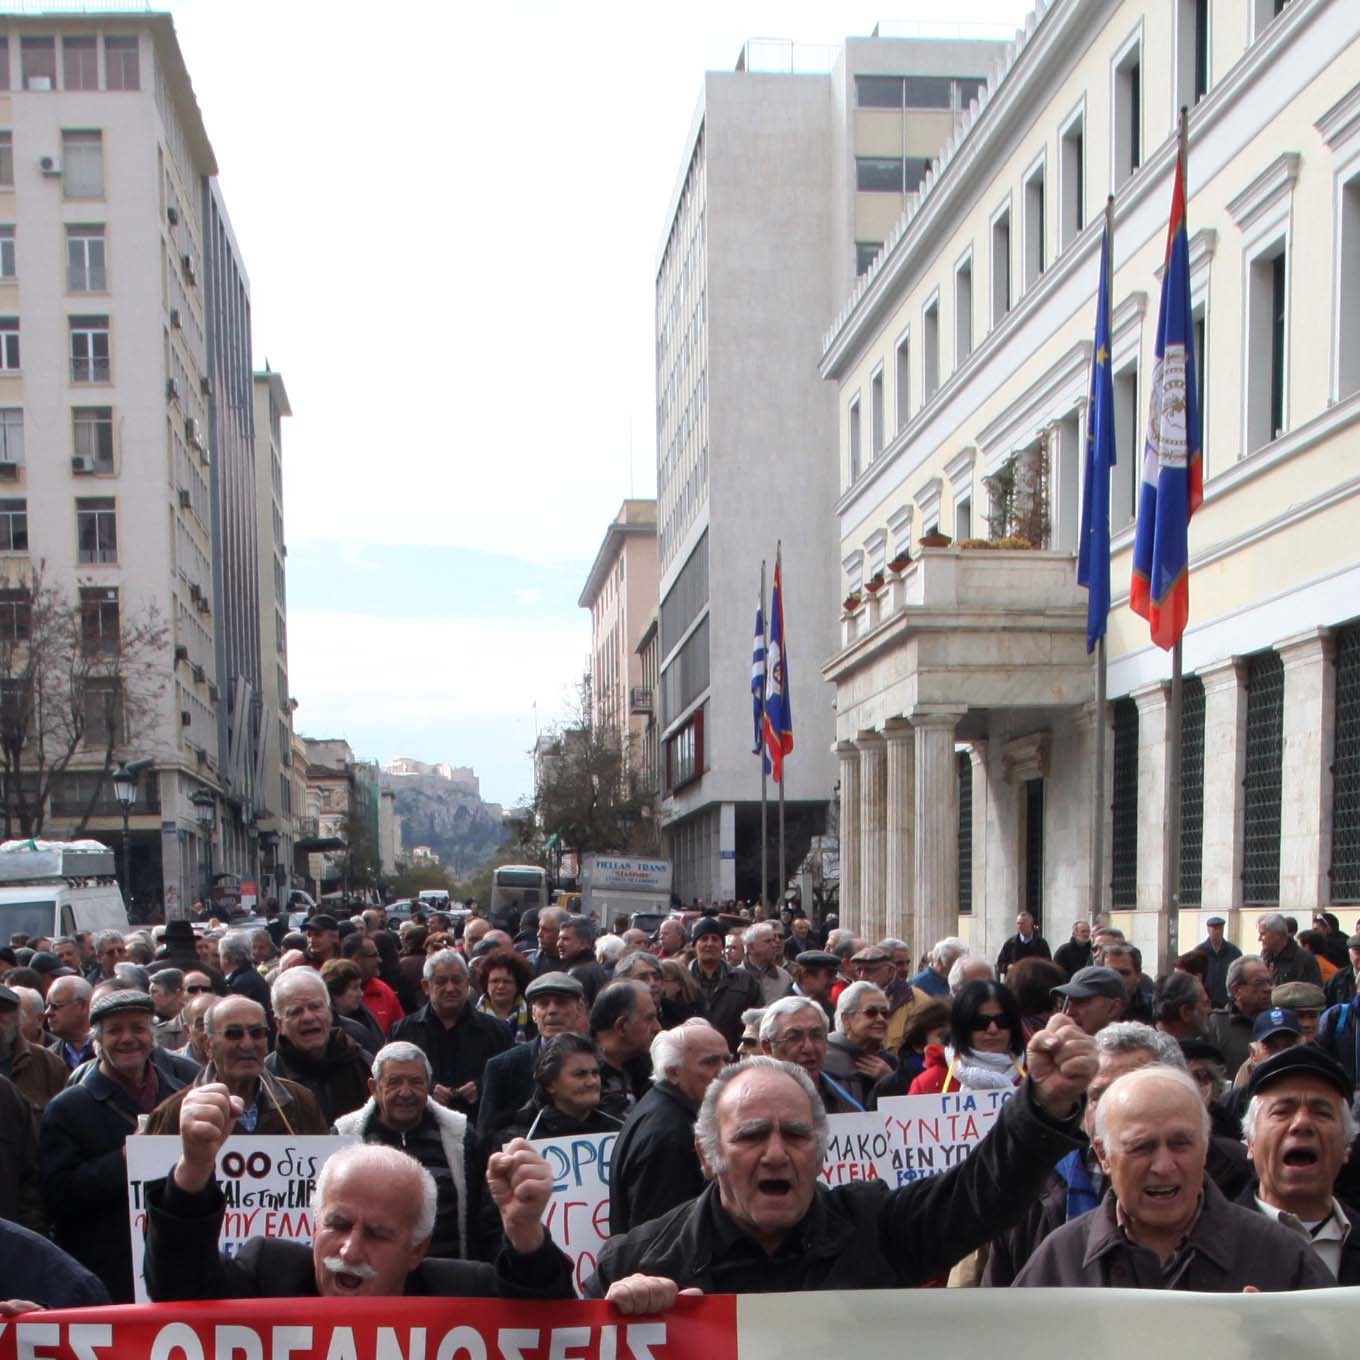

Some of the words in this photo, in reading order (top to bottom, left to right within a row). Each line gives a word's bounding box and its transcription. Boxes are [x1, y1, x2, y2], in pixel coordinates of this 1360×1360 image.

[941, 1095, 976, 1113] ΓΙΑ
[891, 1147, 934, 1170] ΔΕΝ
[820, 1160, 879, 1185] ΥΓΕΙΑ
